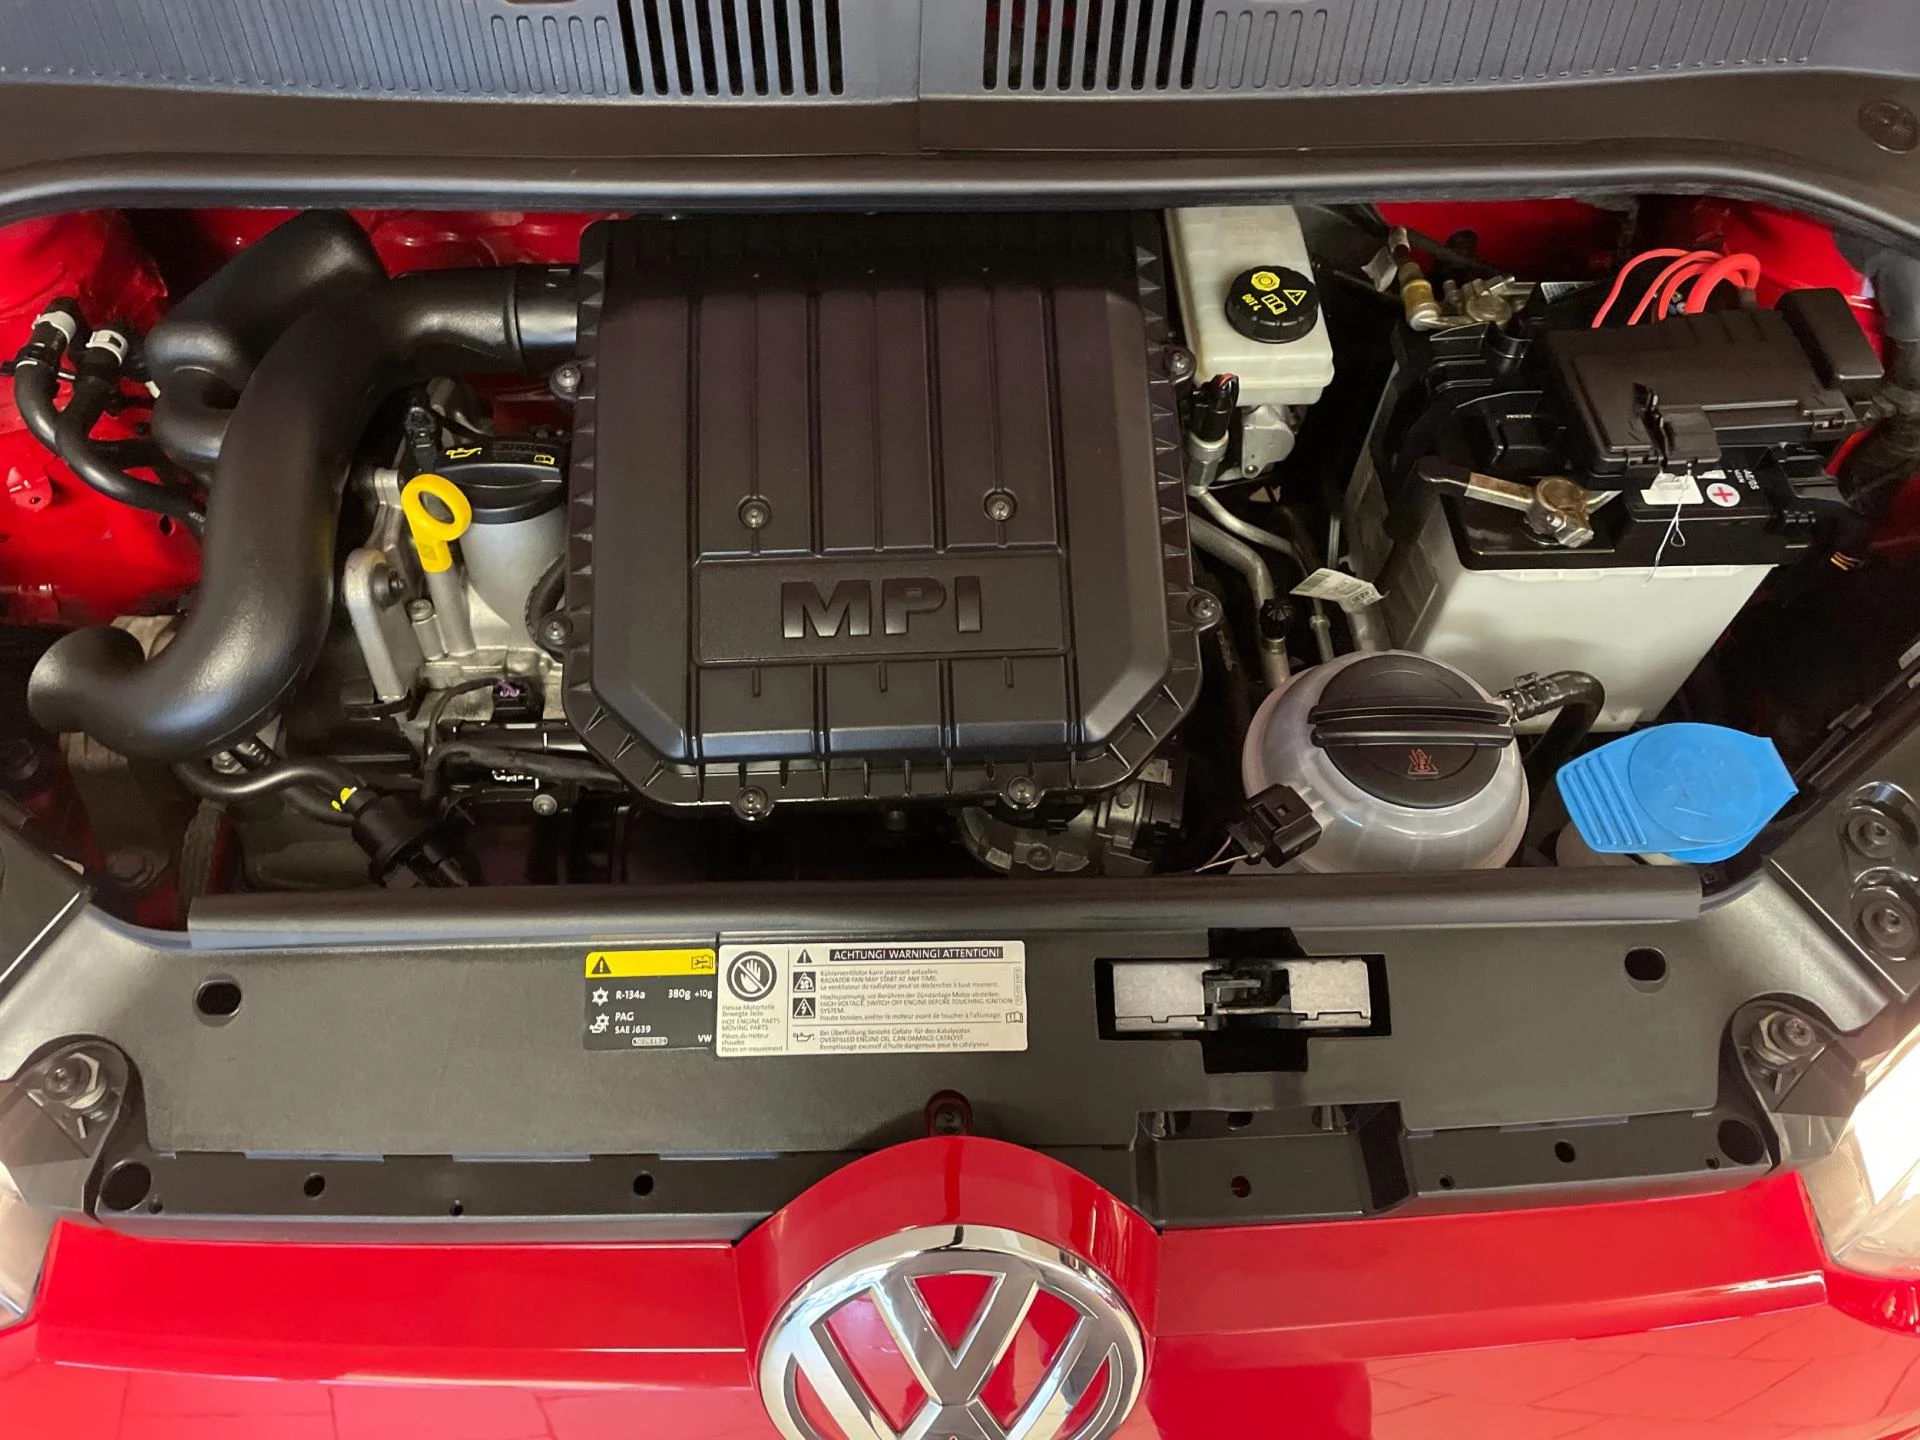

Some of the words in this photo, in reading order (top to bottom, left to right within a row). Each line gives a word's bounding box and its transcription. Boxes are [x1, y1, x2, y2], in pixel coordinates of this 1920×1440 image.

[781, 575, 982, 638] MPI
[834, 950, 886, 960] ACHTUNG!
[888, 949, 940, 959] WARNING!
[942, 948, 999, 958] ATTENTION!
[616, 990, 646, 1000] R-134a
[668, 989, 691, 1000] 380g
[615, 1012, 634, 1021] PAG
[615, 1026, 630, 1034] SAE
[632, 1025, 651, 1034] J639
[698, 1034, 712, 1043] VW
